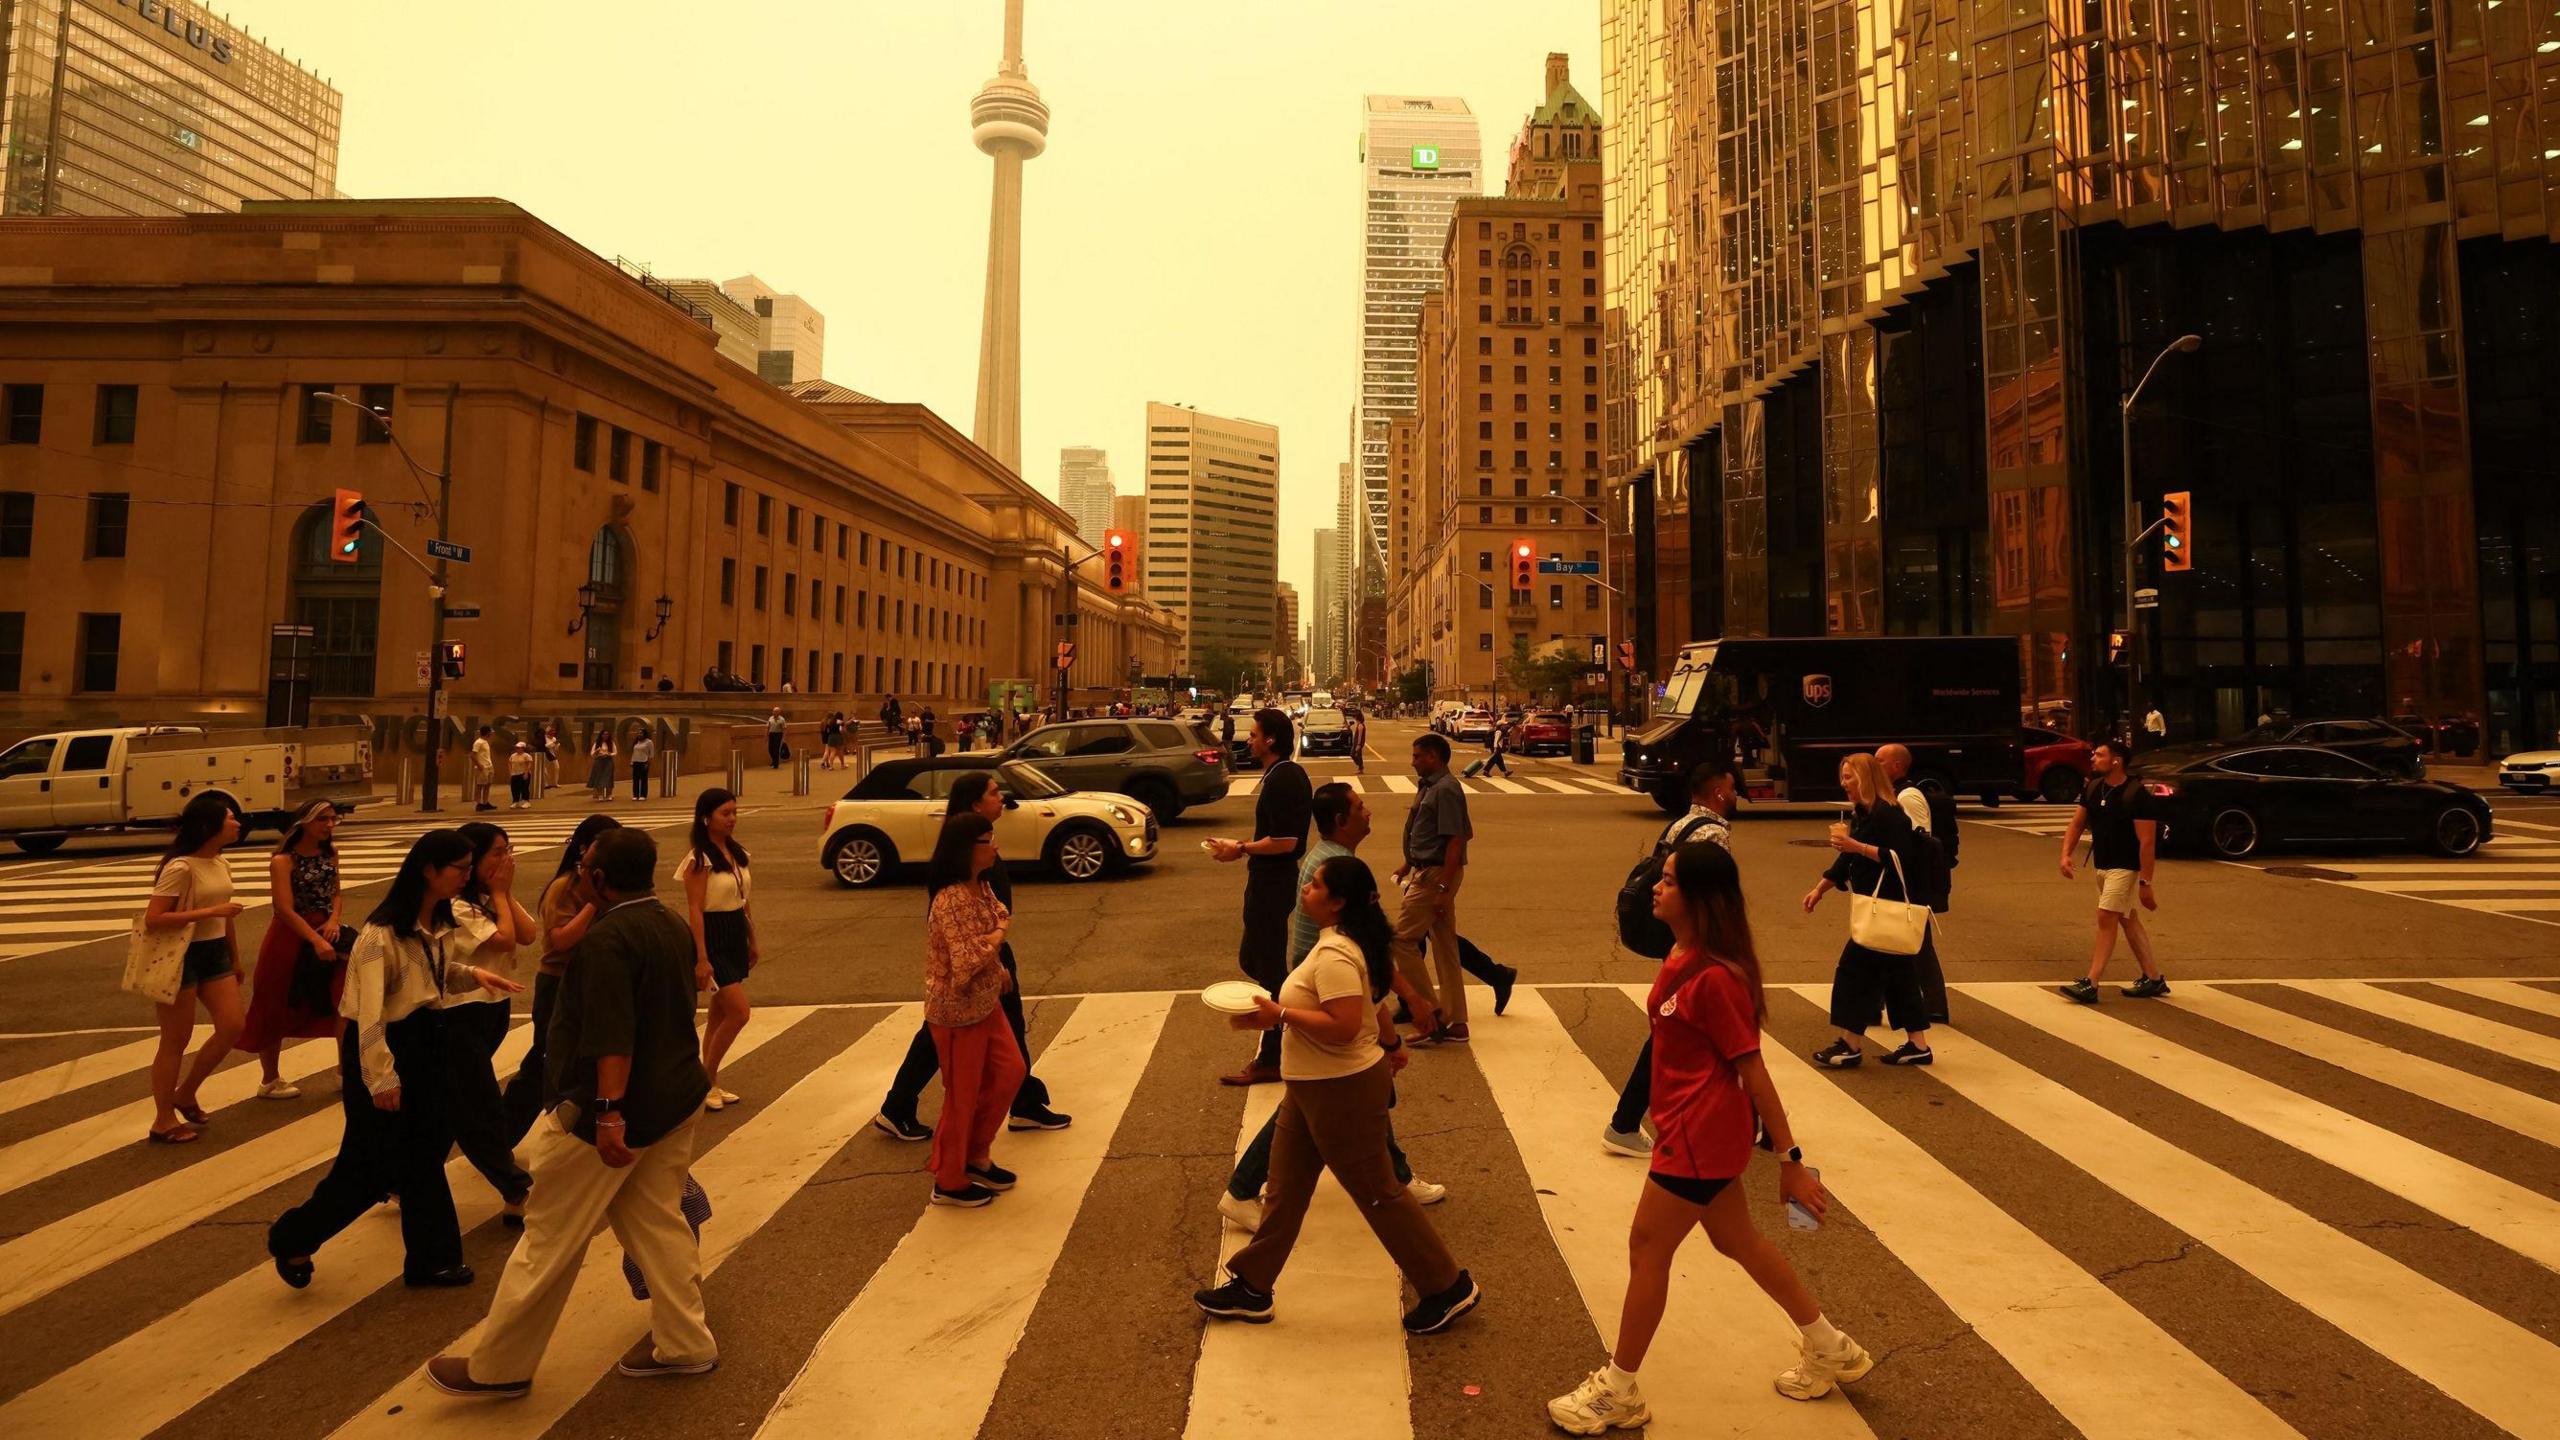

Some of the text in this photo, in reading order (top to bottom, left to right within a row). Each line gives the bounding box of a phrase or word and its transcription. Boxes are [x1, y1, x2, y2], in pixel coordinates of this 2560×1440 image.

[117, 0, 233, 64] ELUS
[1414, 149, 1437, 164] TD
[1555, 562, 1574, 574] Bay
